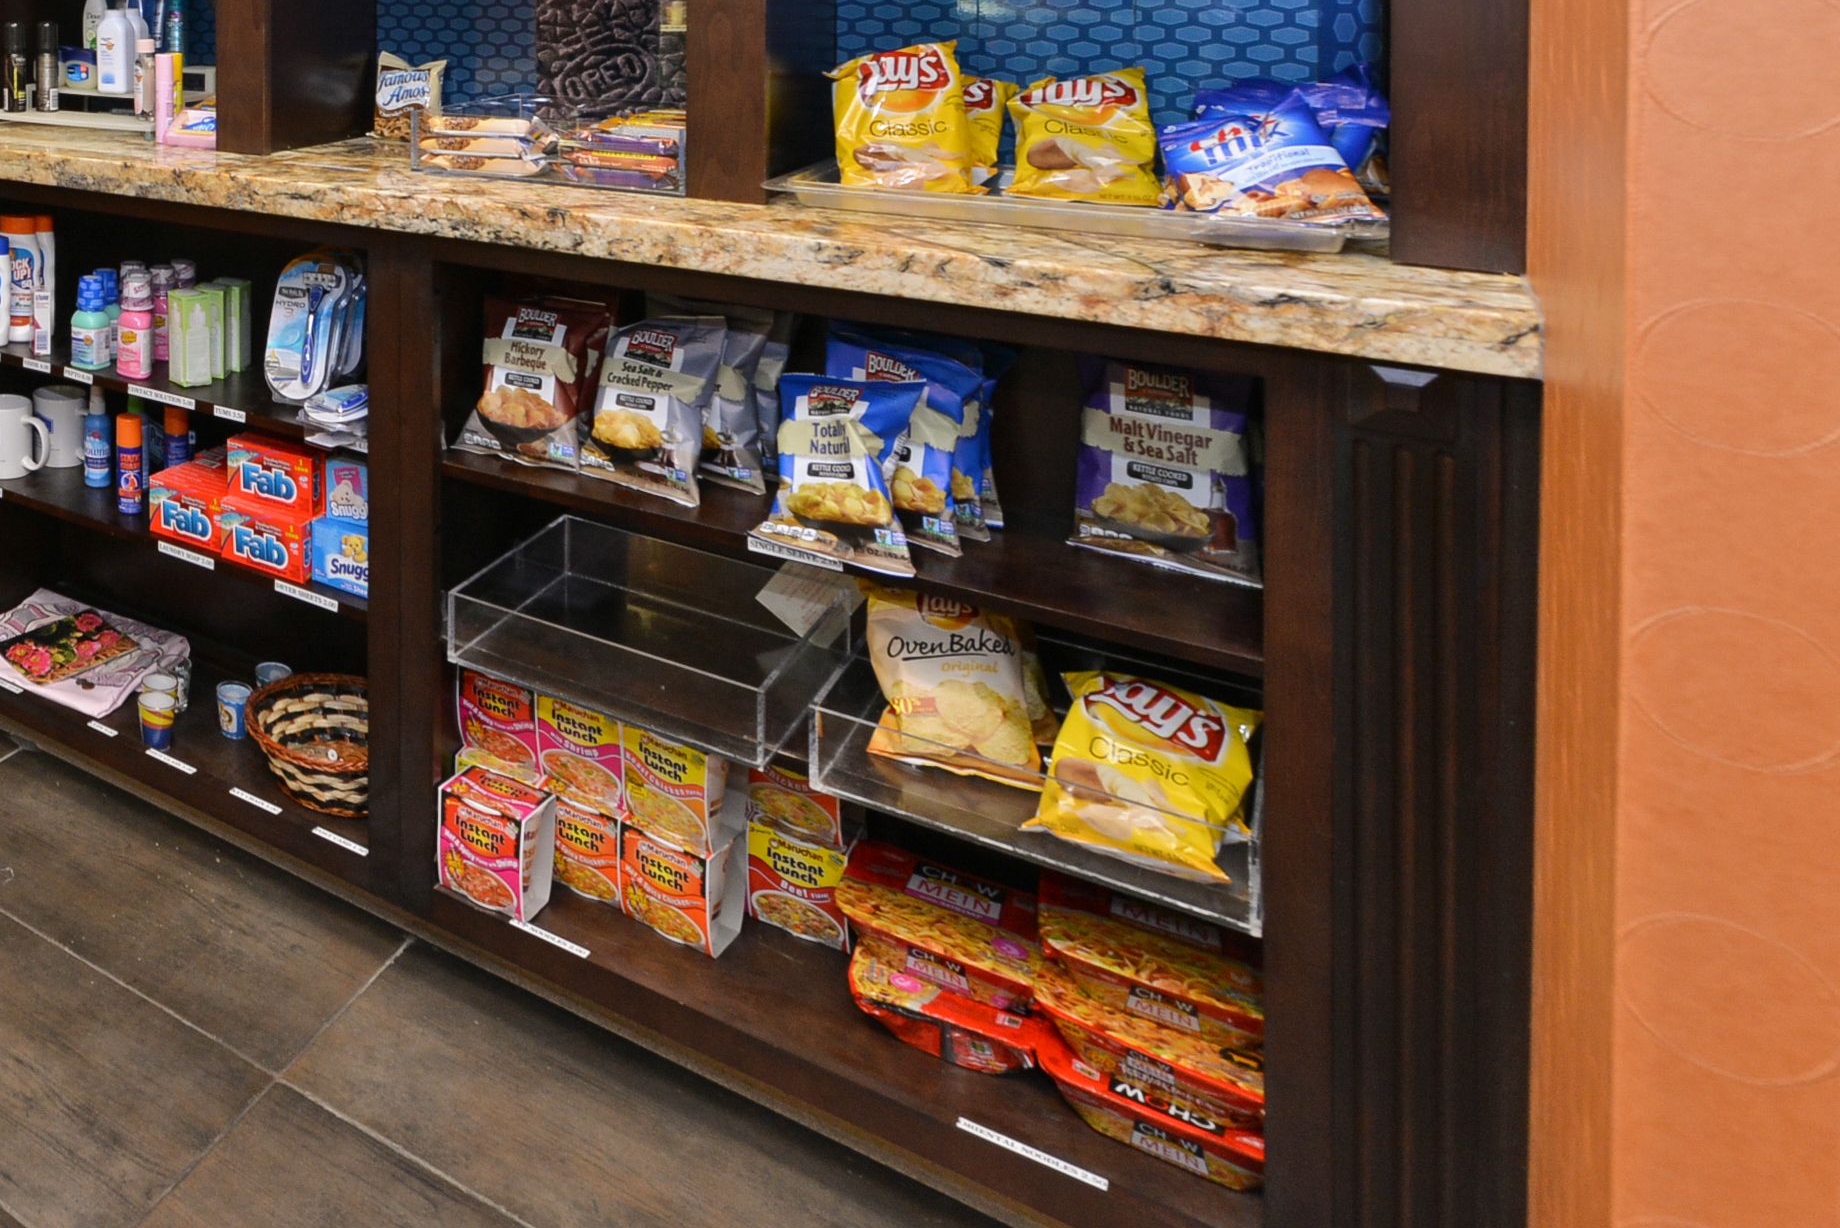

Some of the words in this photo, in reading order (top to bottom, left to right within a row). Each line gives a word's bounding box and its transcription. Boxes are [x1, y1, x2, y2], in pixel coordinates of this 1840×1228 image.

[378, 70, 429, 91] Famous
[565, 51, 644, 98] OREO
[387, 85, 430, 105] Amos
[869, 120, 947, 137] Classic
[1044, 119, 1128, 144] Classic
[276, 300, 305, 308] HYDRO
[284, 308, 294, 318] 3
[518, 308, 558, 327] BOULDER
[511, 341, 545, 357] Hickory
[630, 331, 674, 352] BOULDER
[504, 352, 547, 371] Barbeque
[622, 362, 636, 373] Sea
[638, 364, 655, 376] Salt
[868, 353, 917, 380] BOULDER
[607, 373, 640, 387] Cracked
[641, 378, 673, 393] Pepper
[810, 386, 860, 401] BOULDER
[1127, 368, 1191, 398] BOULDER
[128, 385, 153, 399] CONTACT
[154, 390, 182, 404] SOLUTION
[215, 407, 232, 418] TUMS
[1129, 404, 1163, 417] NATURAL
[812, 421, 846, 438] Totally
[1110, 416, 1143, 438] Malt
[1146, 423, 1213, 453] Vinegar
[810, 437, 851, 455] Natural
[1123, 437, 1135, 453] &
[1138, 439, 1164, 460] Sea
[1167, 444, 1198, 466] Salt
[241, 461, 297, 503] Fab
[1132, 463, 1159, 475] KETTLE
[1159, 467, 1188, 482] COOKED
[160, 499, 212, 541] Fab
[290, 525, 294, 533] 1
[159, 543, 184, 557] LAUNDRY
[185, 551, 201, 563] SOAP
[233, 524, 288, 568] Fab
[750, 540, 784, 554] SINGLE
[786, 546, 814, 561] SERVE
[275, 582, 297, 596] DRYER
[298, 589, 322, 604] SHEETS
[887, 636, 949, 658] Oven
[950, 629, 1015, 655] Baked
[941, 661, 999, 676] original
[473, 685, 520, 709] Instant
[478, 698, 516, 717] Lunch
[552, 708, 603, 736] Instant
[561, 701, 600, 722] Maruchan
[557, 722, 598, 744] Lunch
[563, 740, 599, 757] Shrimp
[639, 742, 689, 775] Instant
[650, 737, 688, 759] Maruchan
[644, 757, 682, 784] Lunch
[1089, 736, 1190, 788] Classic
[649, 773, 685, 795] Chicken
[466, 809, 503, 829] Maruchan
[456, 816, 505, 845] Instant
[560, 828, 599, 852] Lunch
[461, 830, 499, 854] Lunch
[779, 839, 823, 862] Maruchan
[636, 849, 690, 883] Instant
[647, 844, 688, 867] Maruchan
[767, 846, 825, 877] Instant
[641, 864, 683, 892] Lunch
[773, 860, 818, 886] Lunch
[780, 880, 808, 898] Beef
[918, 878, 992, 915] MEIN
[913, 960, 963, 984] MEIN
[1134, 1000, 1192, 1028] MEIN
[1113, 1083, 1217, 1130] CHOW
[1021, 1146, 1079, 1175] NOODLES
[1139, 1136, 1201, 1171] MEIN
